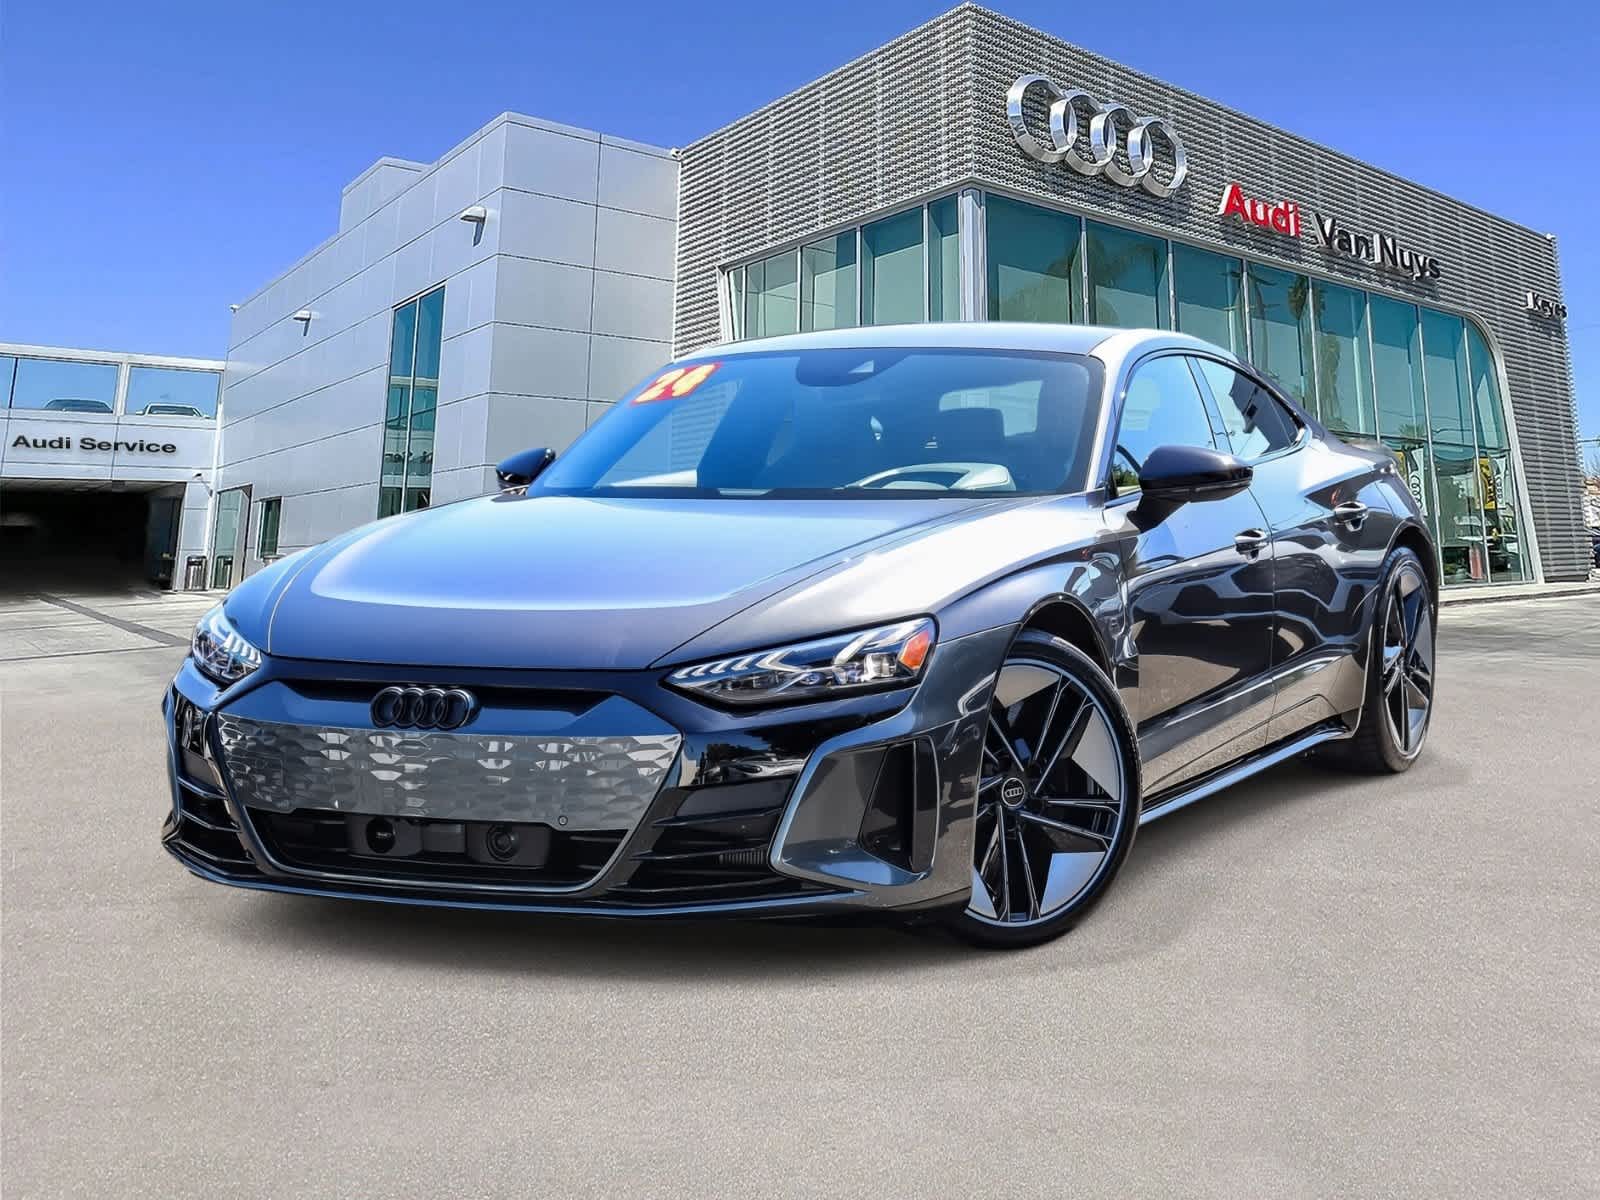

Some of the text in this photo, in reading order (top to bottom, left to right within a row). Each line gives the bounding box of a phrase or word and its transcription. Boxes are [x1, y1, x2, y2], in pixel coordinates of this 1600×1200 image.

[1217, 182, 1440, 280] Audi Van Nuys
[12, 435, 177, 454] Audi Service
